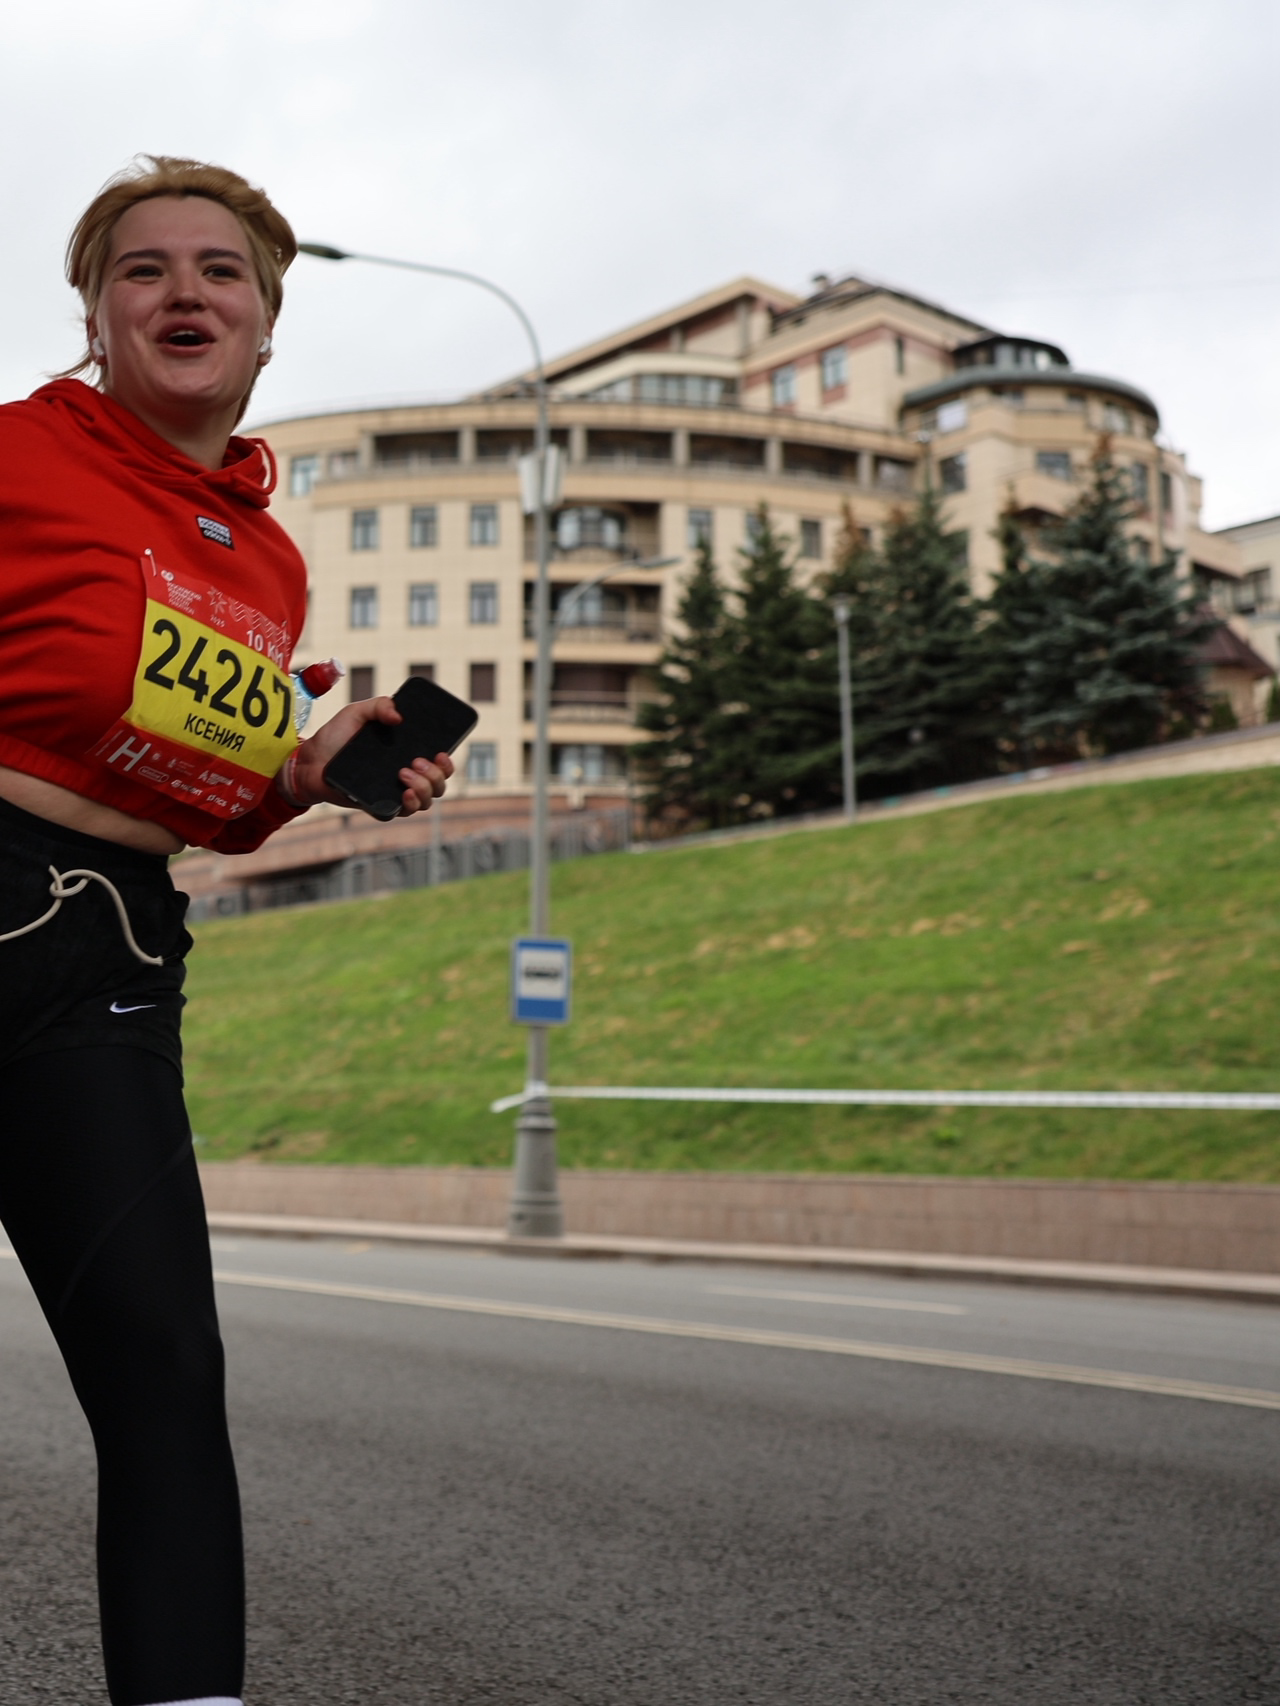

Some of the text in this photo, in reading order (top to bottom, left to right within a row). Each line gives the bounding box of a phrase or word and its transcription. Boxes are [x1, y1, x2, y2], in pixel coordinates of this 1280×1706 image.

[246, 629, 265, 652] 10
[143, 618, 292, 739] 24267
[183, 712, 246, 753] КСЕНИЯ
